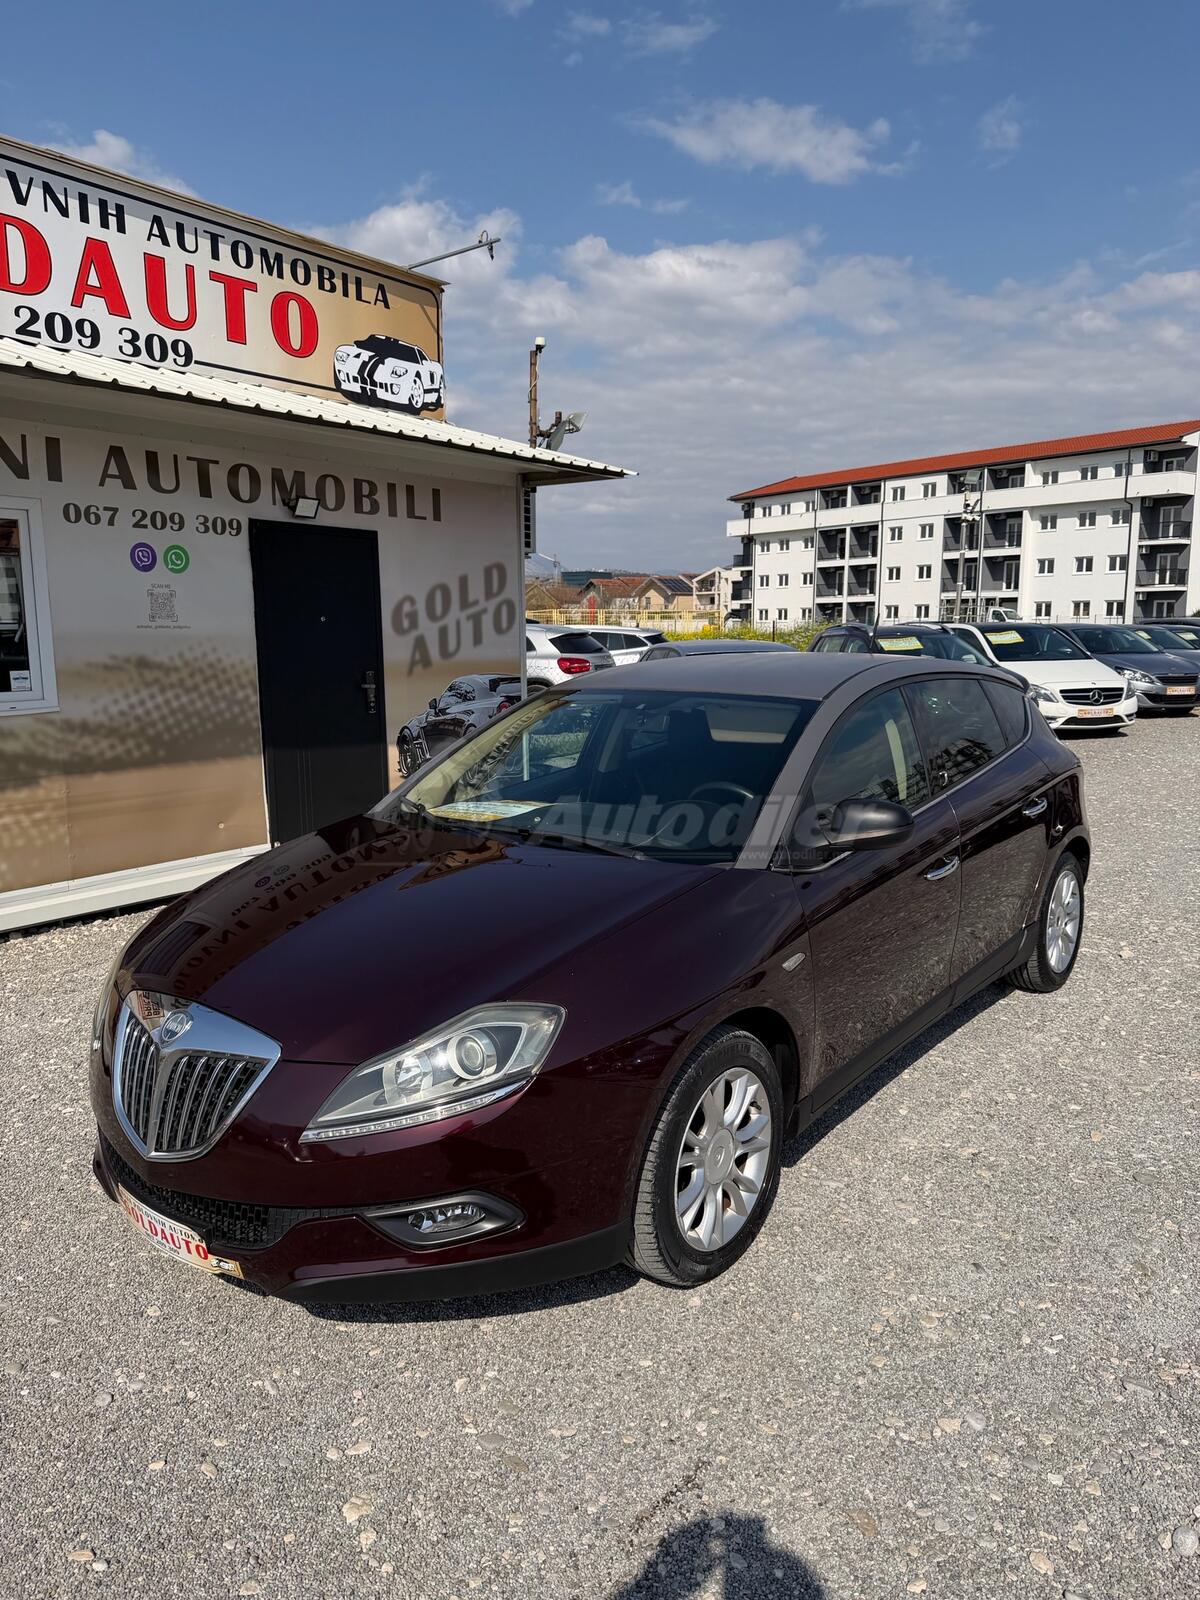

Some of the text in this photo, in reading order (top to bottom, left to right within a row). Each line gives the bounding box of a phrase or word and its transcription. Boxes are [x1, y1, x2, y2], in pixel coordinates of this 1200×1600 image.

[5, 169, 391, 309] VNIH AUTOMOBILA
[0, 212, 320, 359] DAUTO
[14, 305, 194, 368] 209 309
[0, 434, 443, 522] NI AUTOMOBILI
[62, 502, 242, 537] 067 209 309
[391, 560, 508, 637] GOLD
[406, 597, 517, 678] AUTO
